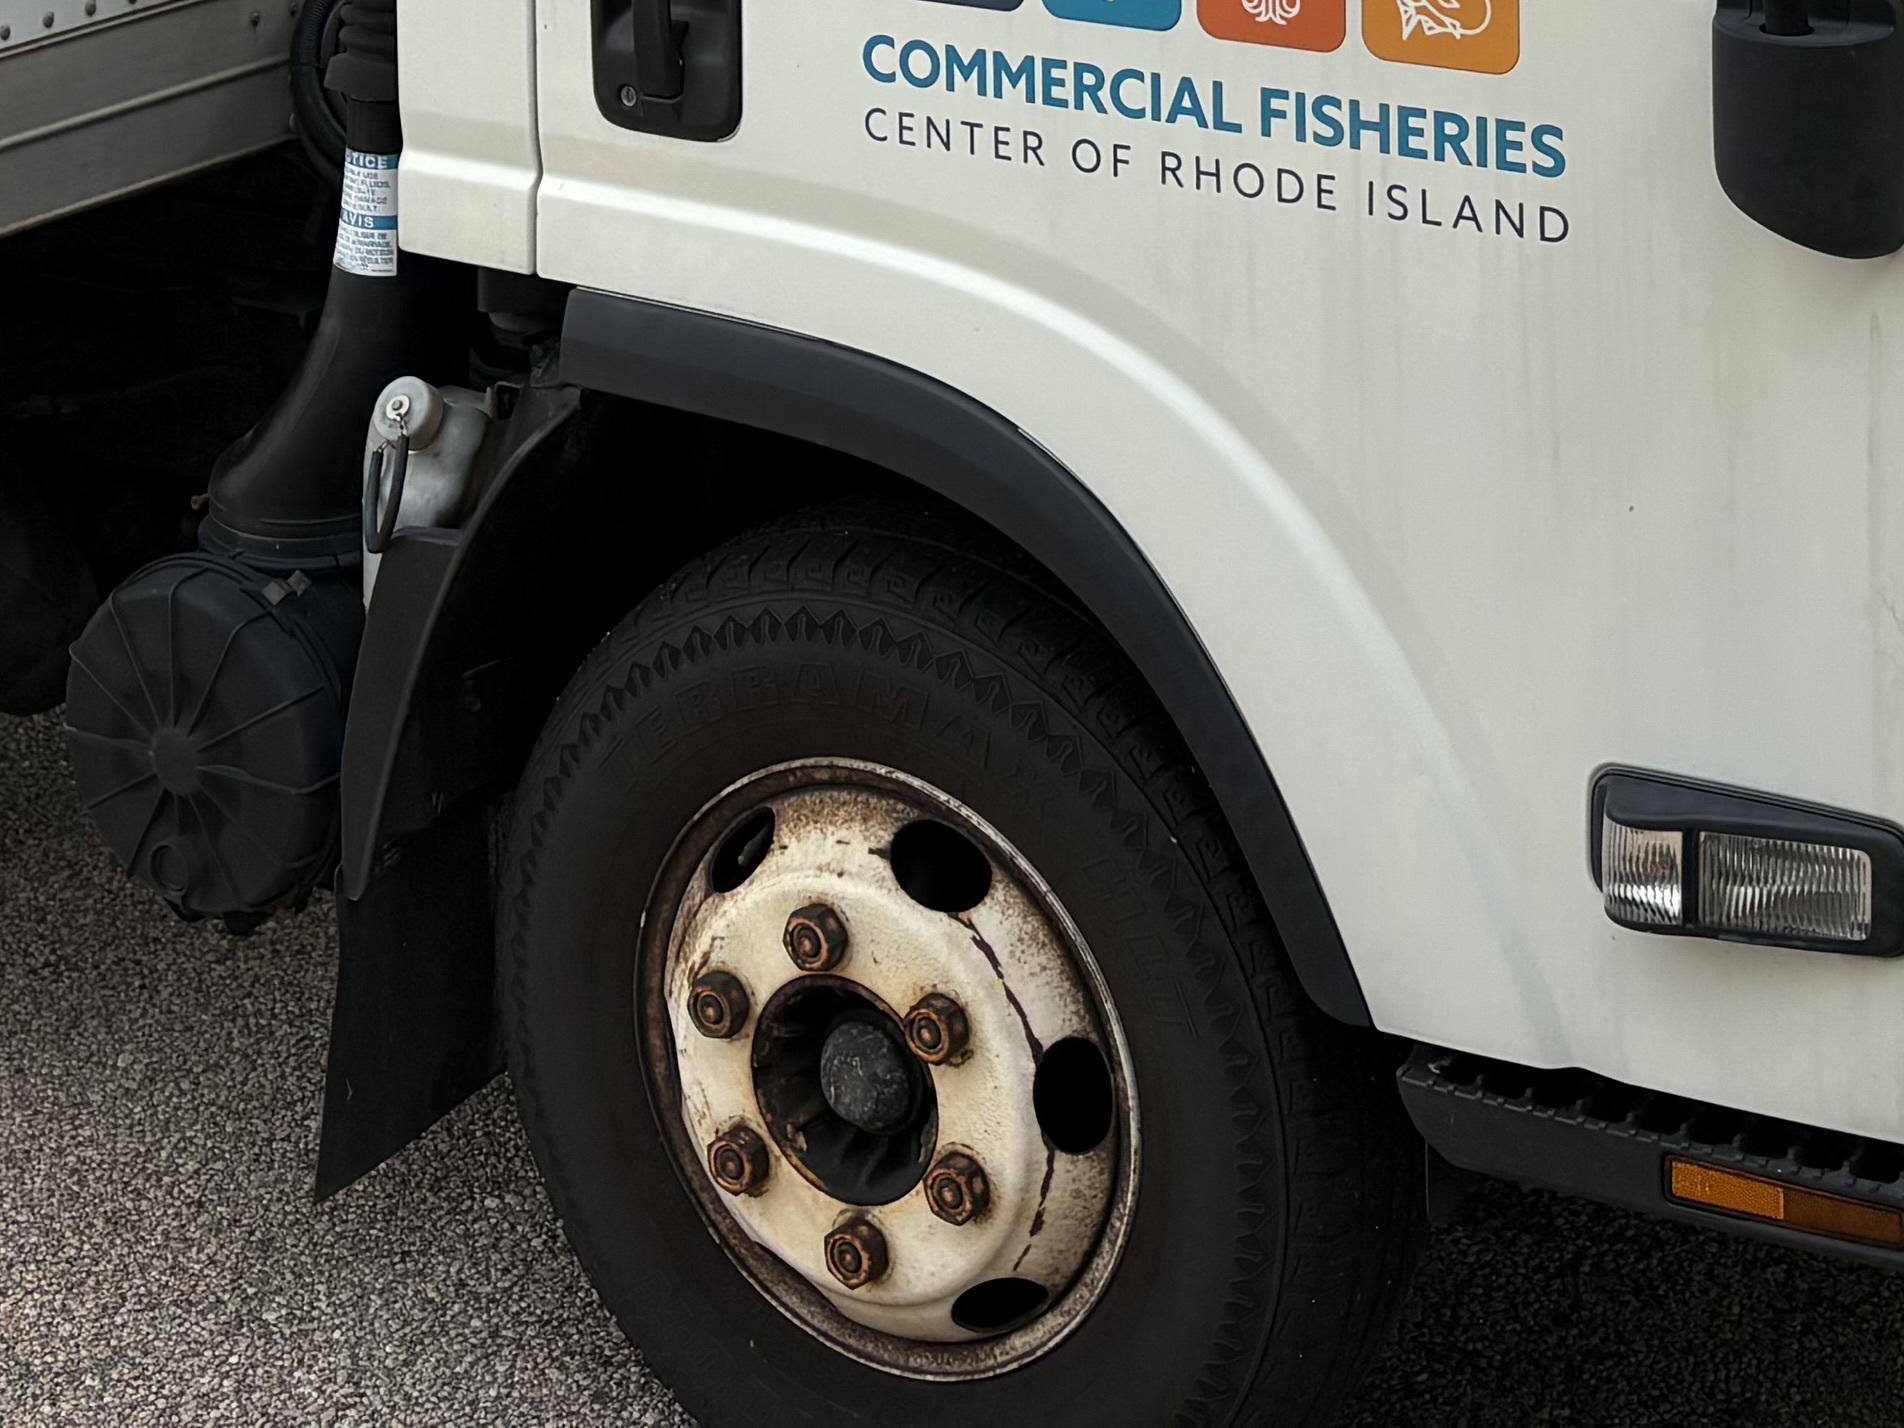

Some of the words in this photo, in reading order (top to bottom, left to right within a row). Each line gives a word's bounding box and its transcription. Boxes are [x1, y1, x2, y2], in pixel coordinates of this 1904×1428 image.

[862, 34, 1242, 135] COMMERCIAL
[1260, 87, 1566, 179] FISHERIES
[342, 210, 374, 228] AVIS
[864, 107, 1045, 167] CENTER
[1072, 138, 1131, 179] OF
[1162, 152, 1337, 212] RHODE
[1368, 180, 1571, 244] ISLAND
